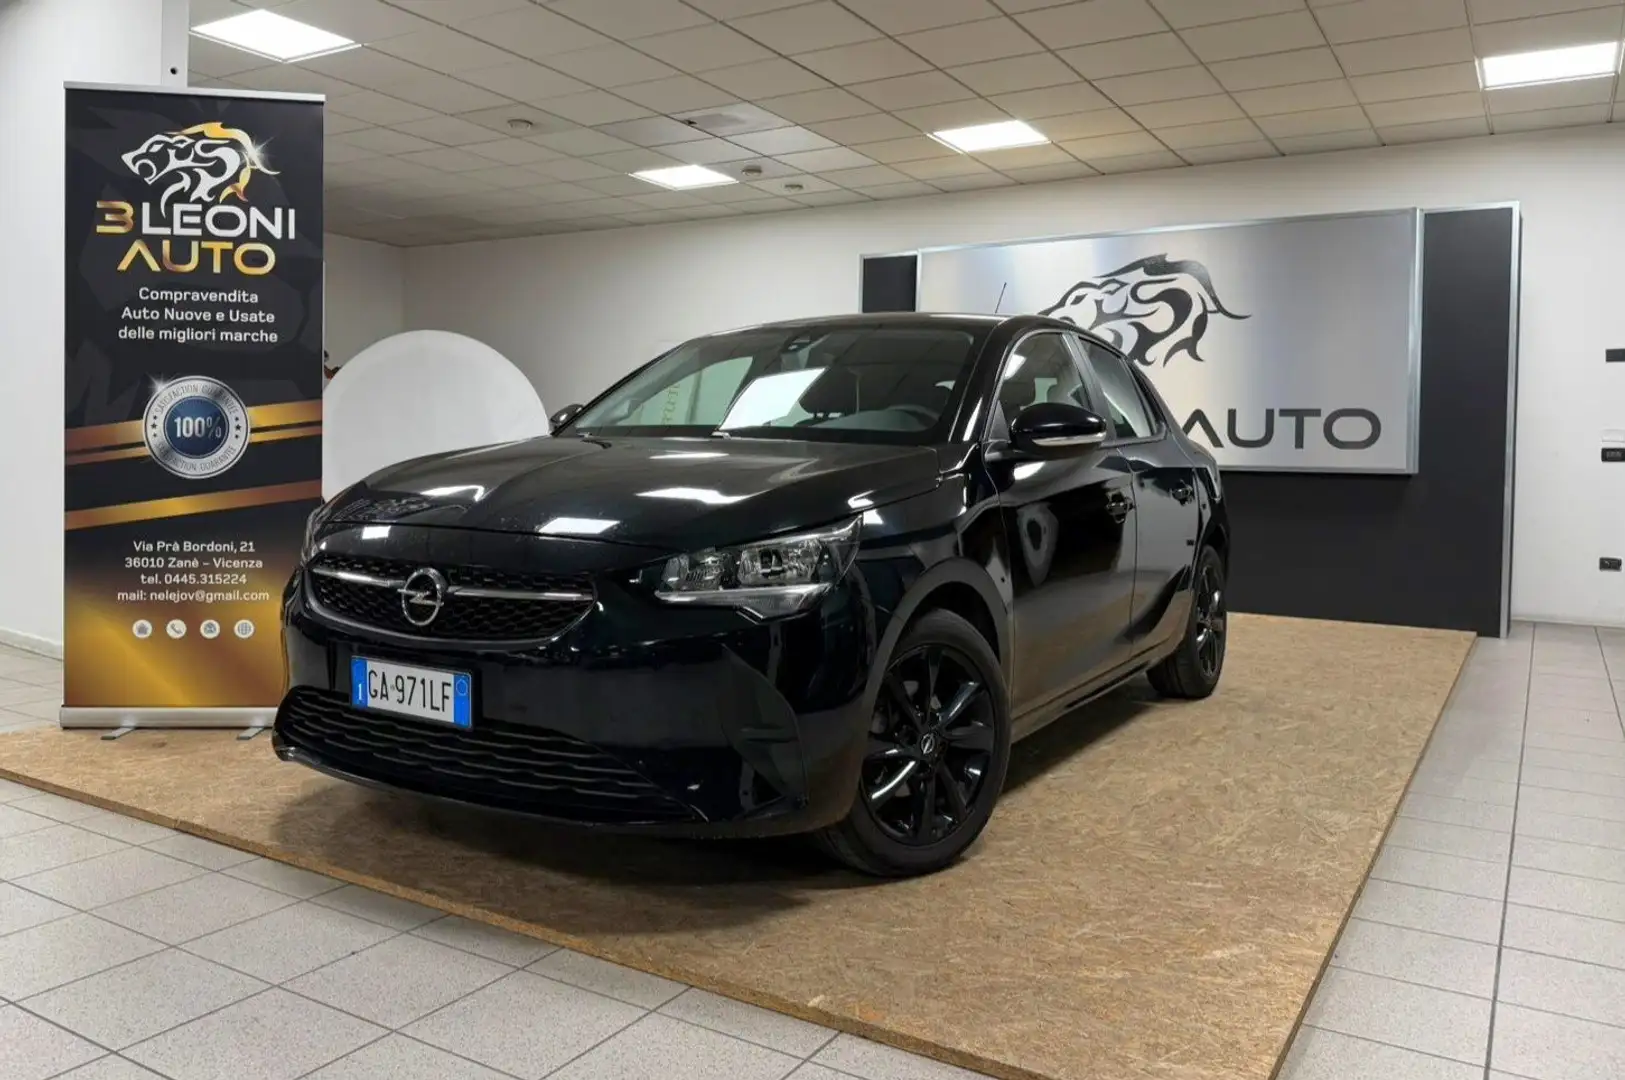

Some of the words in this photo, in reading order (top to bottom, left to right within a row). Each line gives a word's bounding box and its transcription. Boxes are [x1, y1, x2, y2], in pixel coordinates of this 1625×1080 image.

[116, 239, 276, 275] AUTO
[138, 287, 259, 304] Compravendita
[121, 306, 160, 321] Auto
[164, 307, 212, 322] Nuove
[216, 312, 225, 322] e
[229, 309, 275, 323] Usate
[118, 326, 155, 341] delle
[159, 327, 216, 343] migliori
[220, 329, 278, 343] marche
[174, 416, 222, 439] 100%
[1182, 408, 1382, 450] AUTO
[133, 541, 154, 552] Via
[156, 541, 180, 552] Prà
[183, 541, 237, 554] Bordoni,
[239, 541, 256, 553] 21
[125, 557, 165, 568] 36010
[168, 557, 199, 569] Zanè
[212, 557, 263, 569] Vicenza
[140, 573, 162, 584] tel.
[164, 573, 248, 585] 0445.315224
[117, 589, 147, 601] mail:
[150, 589, 270, 603] nelejov@gmail.com
[394, 674, 452, 712] 971LF
